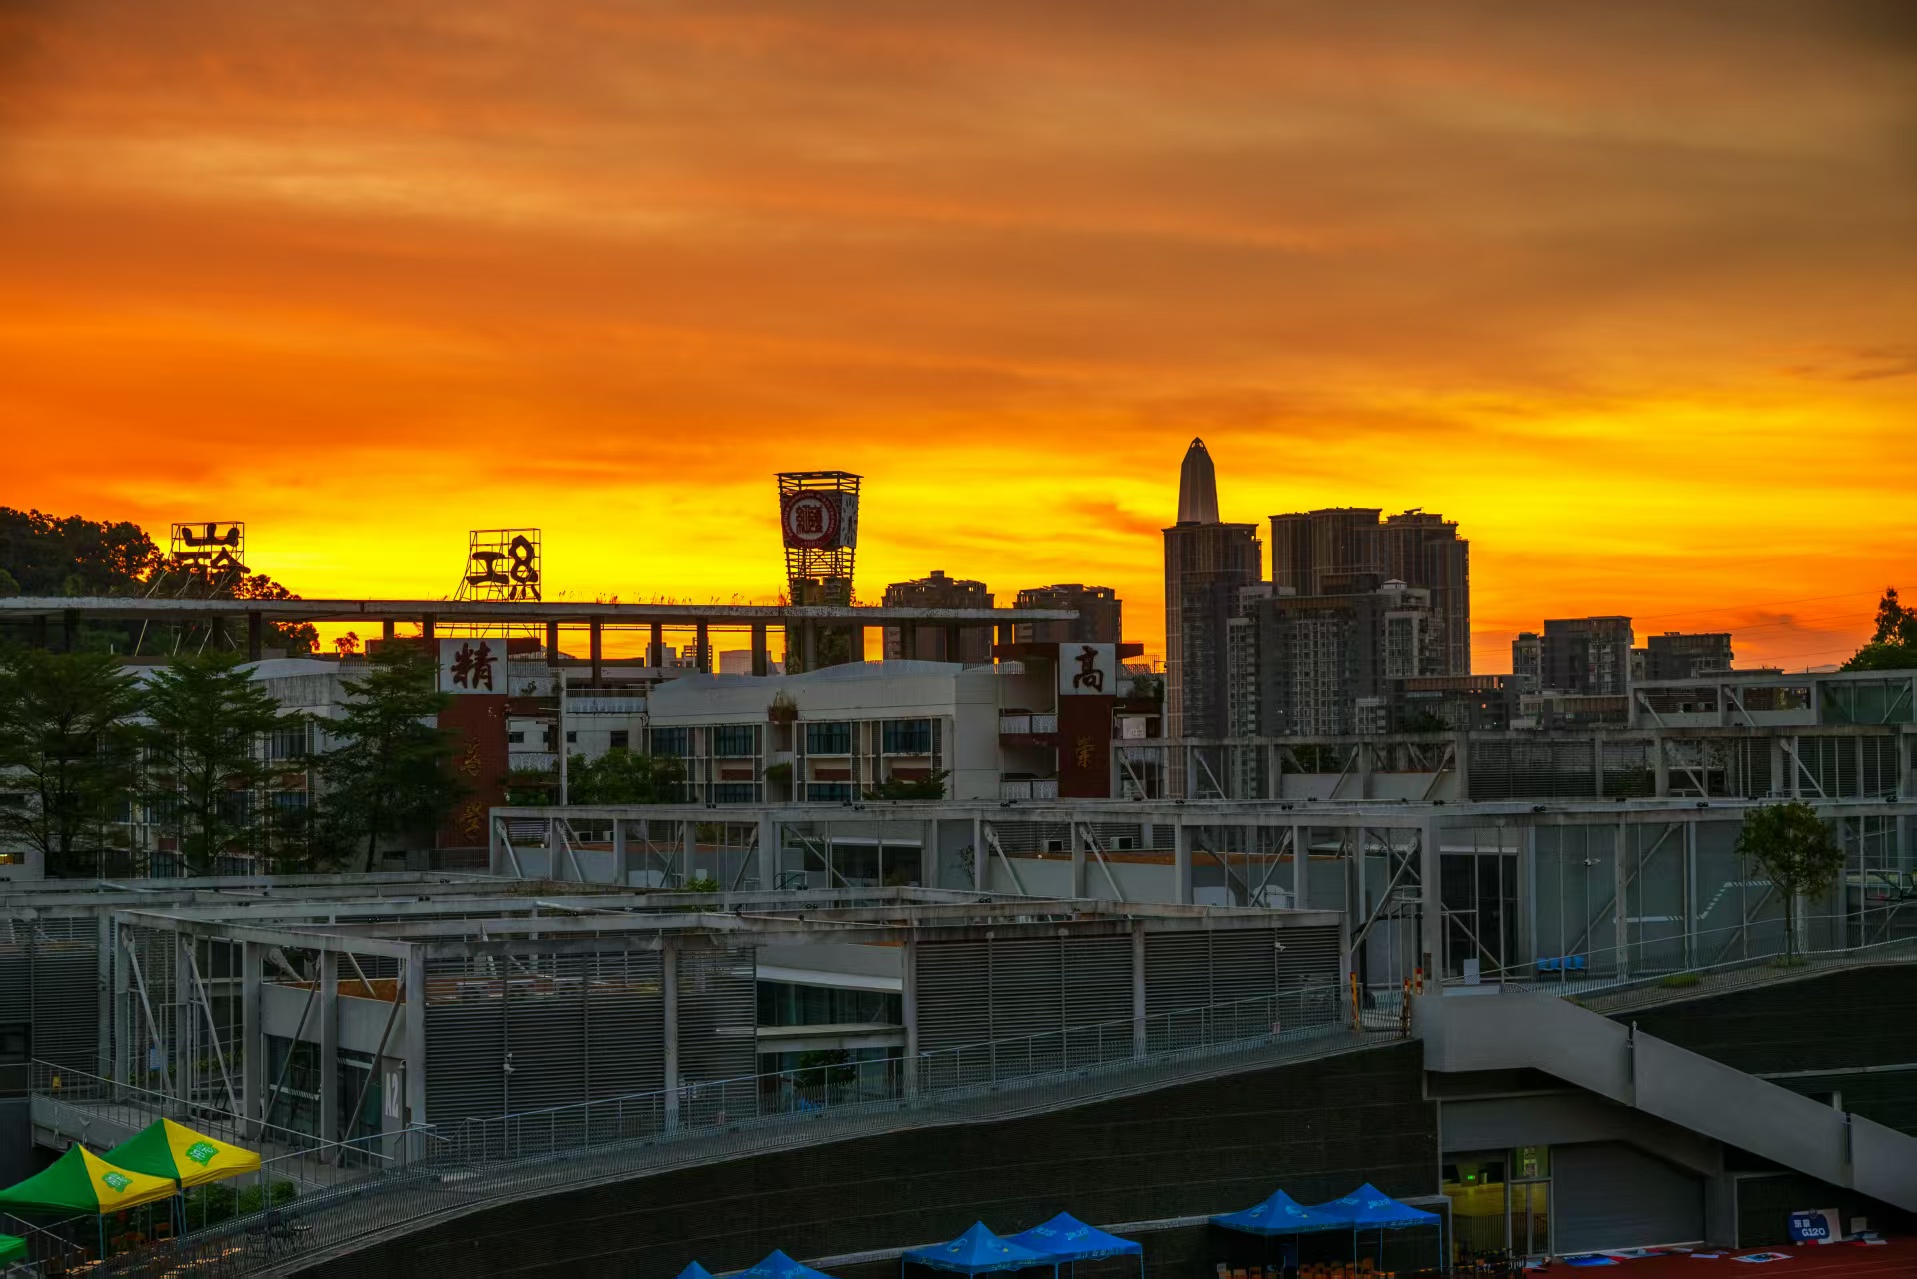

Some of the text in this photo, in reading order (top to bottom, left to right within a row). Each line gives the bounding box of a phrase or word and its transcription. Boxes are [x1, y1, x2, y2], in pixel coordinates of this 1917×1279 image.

[451, 641, 498, 691] 精
[1073, 645, 1104, 693] 高
[385, 1072, 399, 1118] A2
[1801, 1227, 1826, 1237] G120
